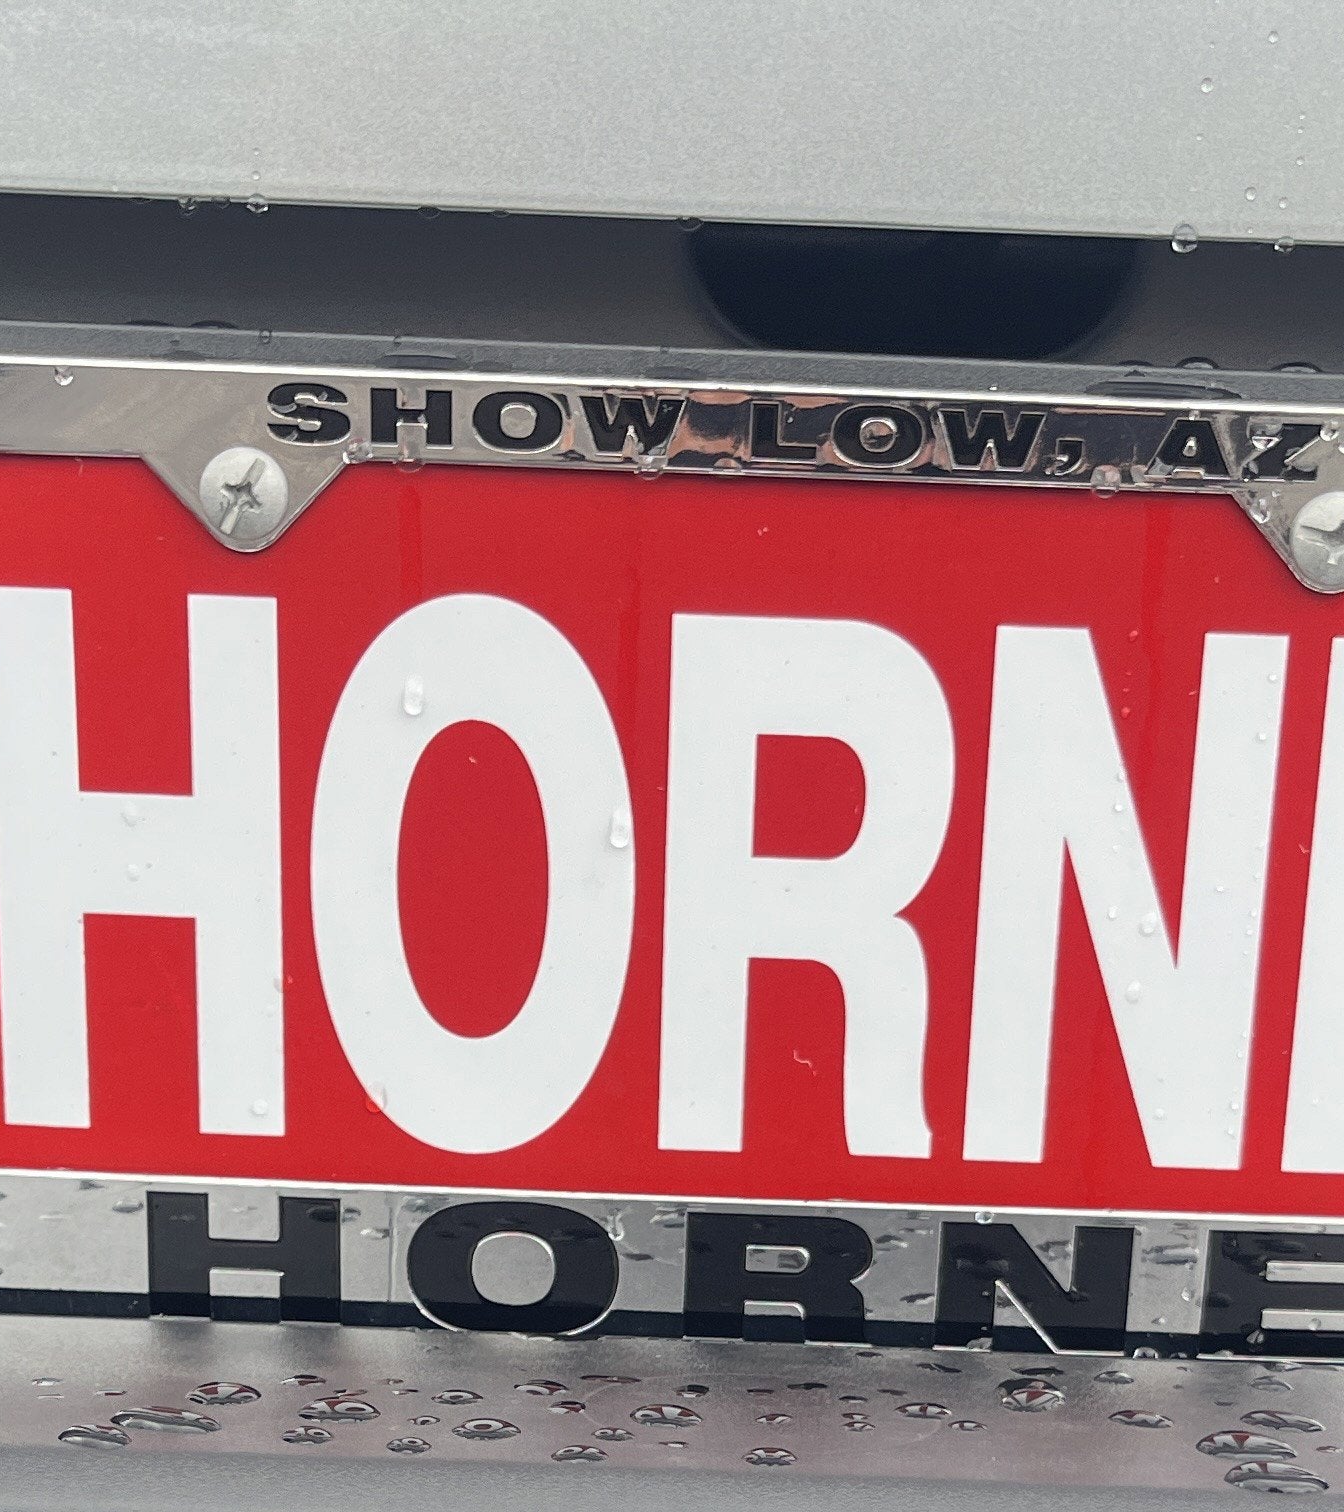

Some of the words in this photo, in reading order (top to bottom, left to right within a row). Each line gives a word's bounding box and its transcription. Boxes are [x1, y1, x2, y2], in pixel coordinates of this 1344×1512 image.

[266, 381, 686, 457] SHOW
[749, 400, 1084, 476] LOW,
[1144, 417, 1324, 482] AZ
